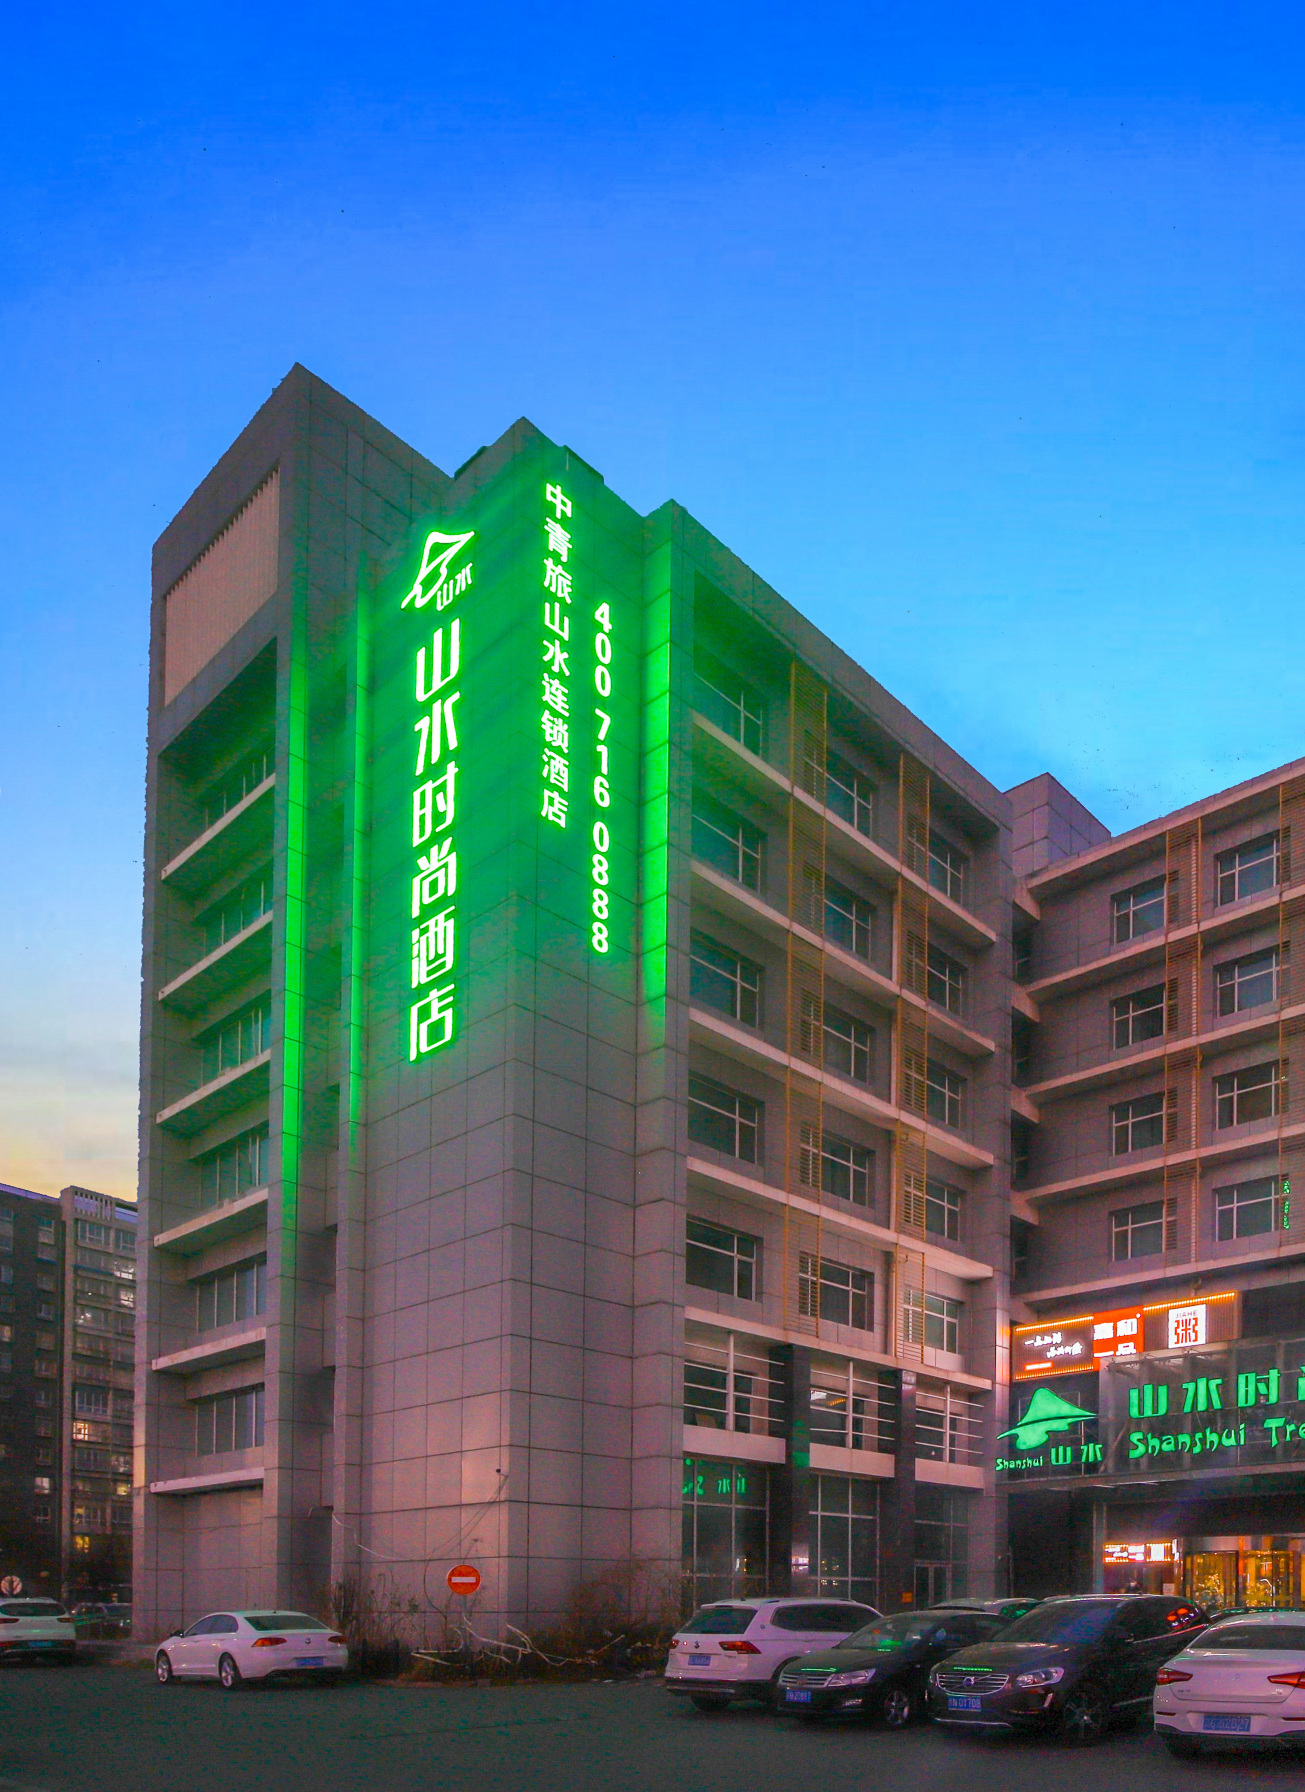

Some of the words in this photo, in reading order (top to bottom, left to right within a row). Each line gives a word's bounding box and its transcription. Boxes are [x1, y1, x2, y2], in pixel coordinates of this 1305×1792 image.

[540, 482, 573, 829] 中青旅山水连锁酒店
[594, 602, 612, 698] 400
[593, 709, 612, 808] 716
[409, 618, 461, 1062] 山水时尚酒店
[592, 820, 610, 954] 0888
[995, 1456, 1043, 1471] Shanshui
[1051, 1443, 1103, 1465] 山水
[1128, 1422, 1246, 1460] Shanshui
